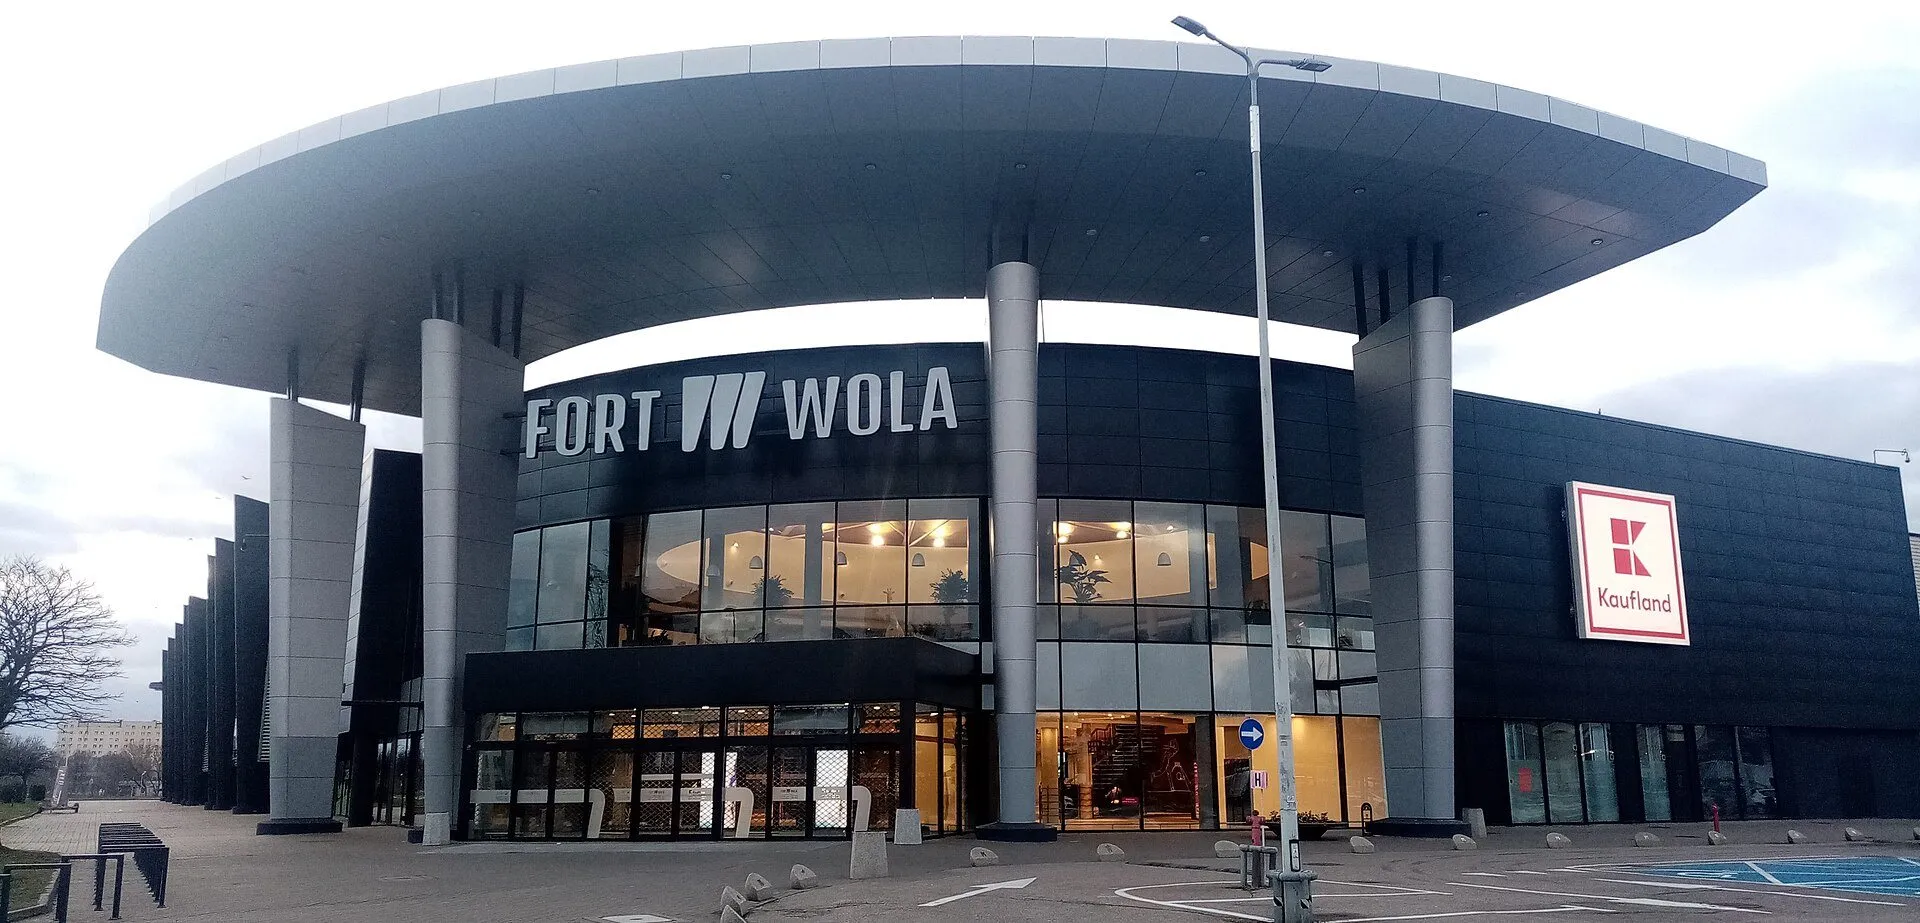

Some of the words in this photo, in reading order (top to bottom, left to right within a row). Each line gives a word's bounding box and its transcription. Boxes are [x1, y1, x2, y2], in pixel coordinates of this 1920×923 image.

[525, 390, 661, 459] FORT
[782, 366, 959, 440] WOLA
[1598, 587, 1672, 613] Kaufland
